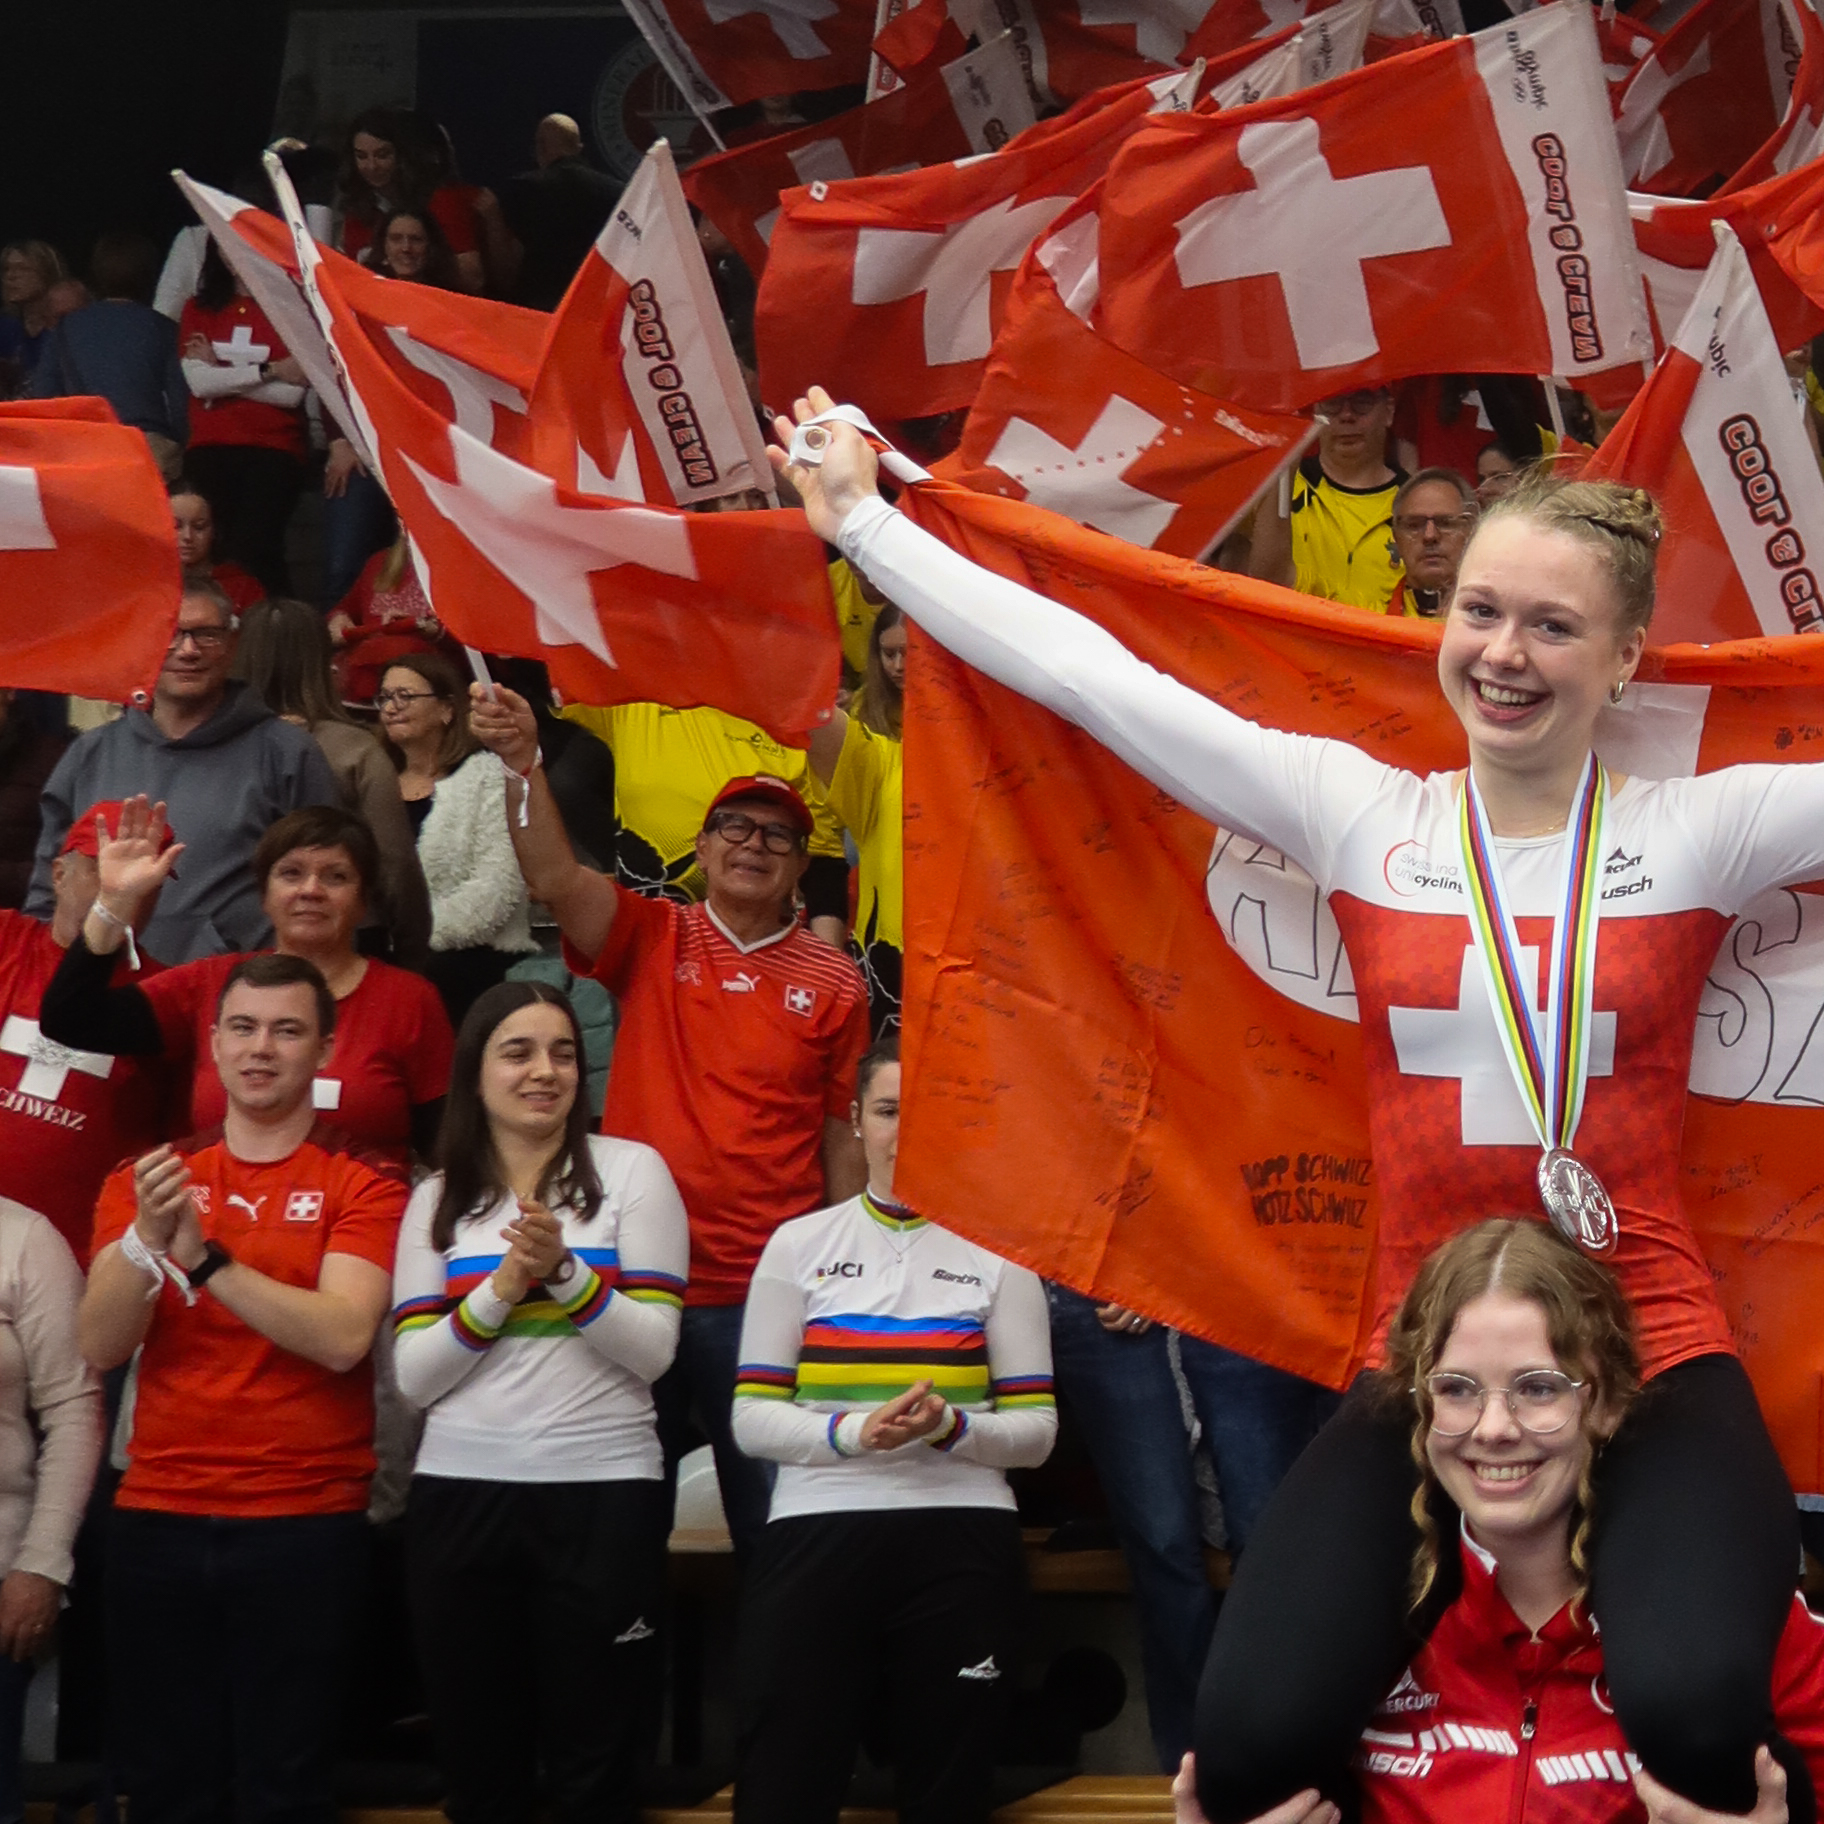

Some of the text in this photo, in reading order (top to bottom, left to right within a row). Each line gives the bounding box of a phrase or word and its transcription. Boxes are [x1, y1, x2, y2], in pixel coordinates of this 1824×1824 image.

[1605, 854, 1643, 874] RCURY
[1602, 875, 1653, 900] usch
[1376, 1691, 1441, 1714] ERCURY
